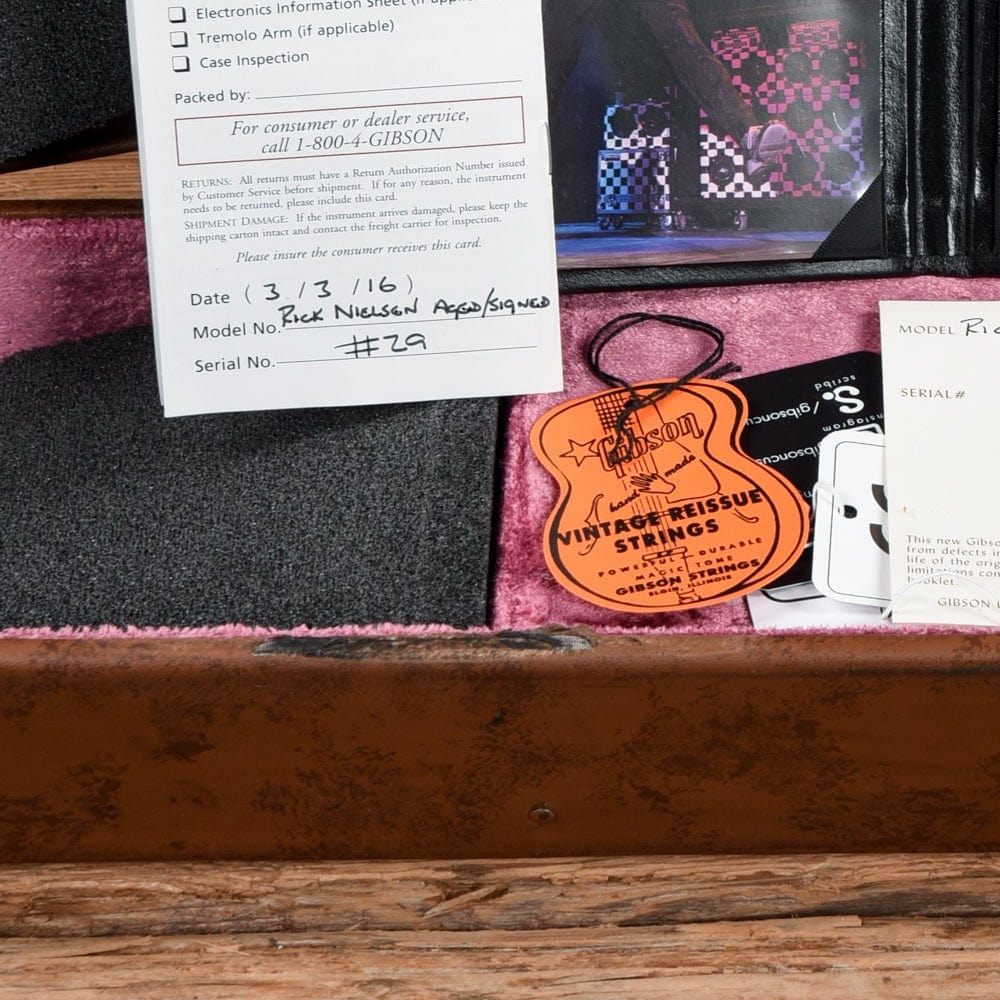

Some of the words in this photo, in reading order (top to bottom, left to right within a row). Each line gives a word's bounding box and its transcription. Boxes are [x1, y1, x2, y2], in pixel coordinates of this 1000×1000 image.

[196, 4, 272, 20] Electronics
[197, 29, 257, 44] Tremolo
[262, 28, 292, 40] Arm
[297, 24, 312, 39] (if
[318, 19, 394, 38] applicable)
[200, 57, 232, 69] Case
[237, 51, 309, 68] Inspection
[175, 90, 224, 104] Packed
[230, 89, 250, 103] by:
[230, 120, 259, 136] For
[264, 120, 338, 134] consumer
[342, 118, 359, 128] or
[363, 109, 411, 127] dealer
[415, 108, 469, 124] service,
[261, 137, 290, 154] call
[296, 128, 444, 152] 1-800-4-GIBSON
[236, 251, 270, 263] Please
[273, 250, 308, 260] insure
[311, 246, 328, 258] the
[331, 247, 384, 257] consumer
[387, 242, 428, 253] receives
[431, 239, 451, 250] this
[455, 236, 482, 249] card.
[190, 293, 230, 306] Date
[193, 322, 246, 339] Model
[253, 322, 281, 335] No.
[899, 325, 955, 335] MODEL
[195, 356, 240, 373] Serial
[247, 356, 275, 369] No.
[334, 333, 427, 359] #29
[814, 375, 856, 391] scribd
[822, 413, 884, 432] nstagram
[756, 442, 821, 465] ibsoncu
[609, 490, 640, 513] hand
[664, 454, 697, 477] made
[557, 510, 661, 546] VINTAGE
[668, 489, 763, 523] REISSUE
[614, 518, 720, 553] STRINGS
[598, 557, 676, 578] POWERFUL
[699, 537, 762, 556] DURABLE
[635, 566, 684, 581] MAGIC
[695, 555, 733, 568] TONE
[615, 575, 682, 596] GIBSON
[688, 558, 761, 581] STRINGS
[937, 597, 990, 608] GIBSON
